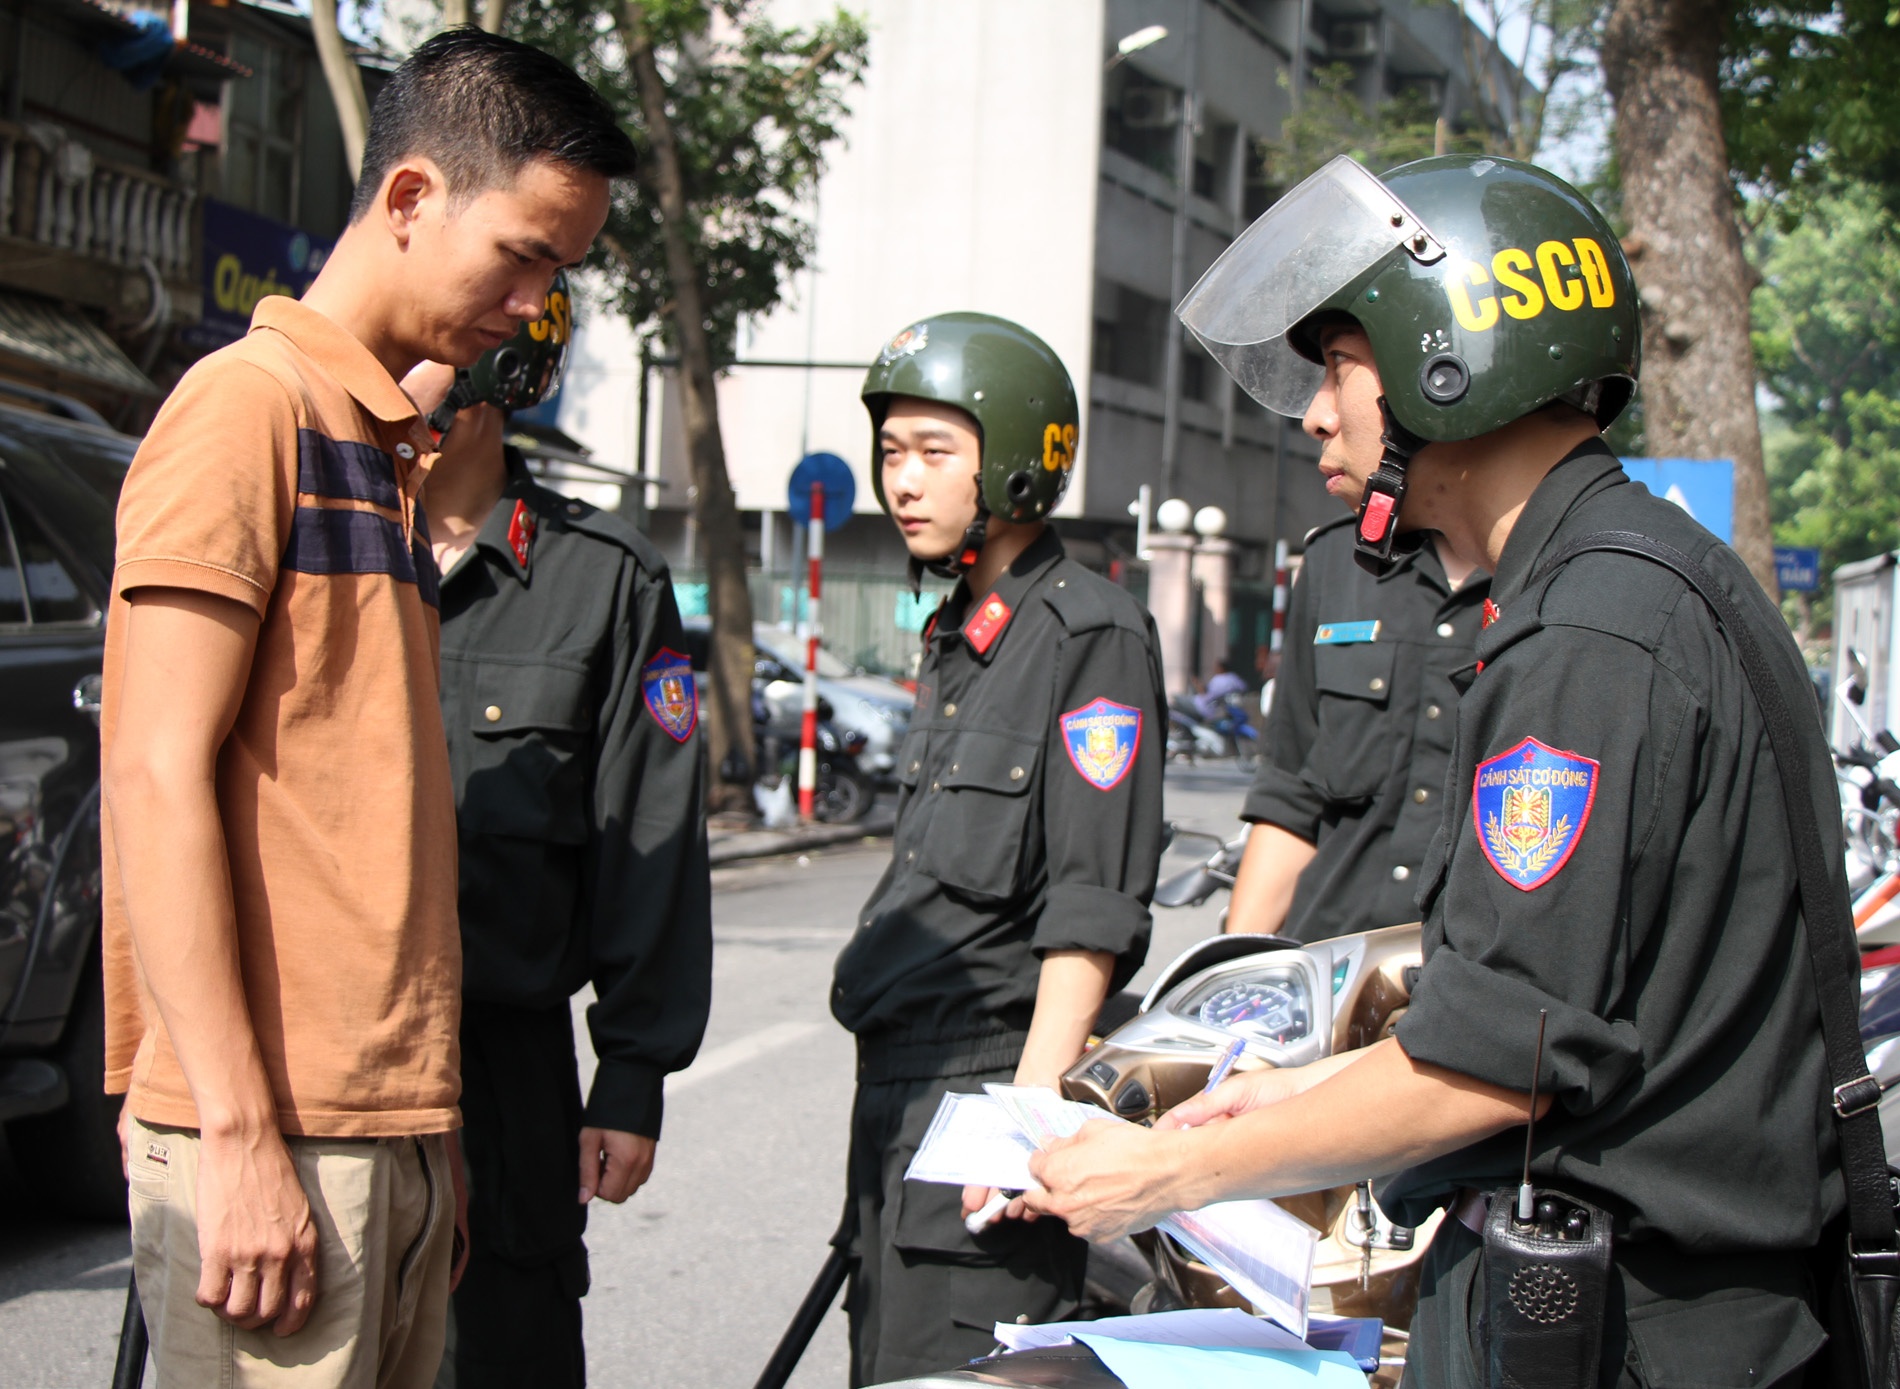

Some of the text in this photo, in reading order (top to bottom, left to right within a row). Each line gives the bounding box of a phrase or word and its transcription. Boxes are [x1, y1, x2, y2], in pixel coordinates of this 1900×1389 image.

[1444, 237, 1615, 333] CSCĐ
[1509, 766, 1532, 786] SÁT
[1532, 766, 1552, 786] CƠ
[1551, 767, 1589, 789] ĐỘNG
